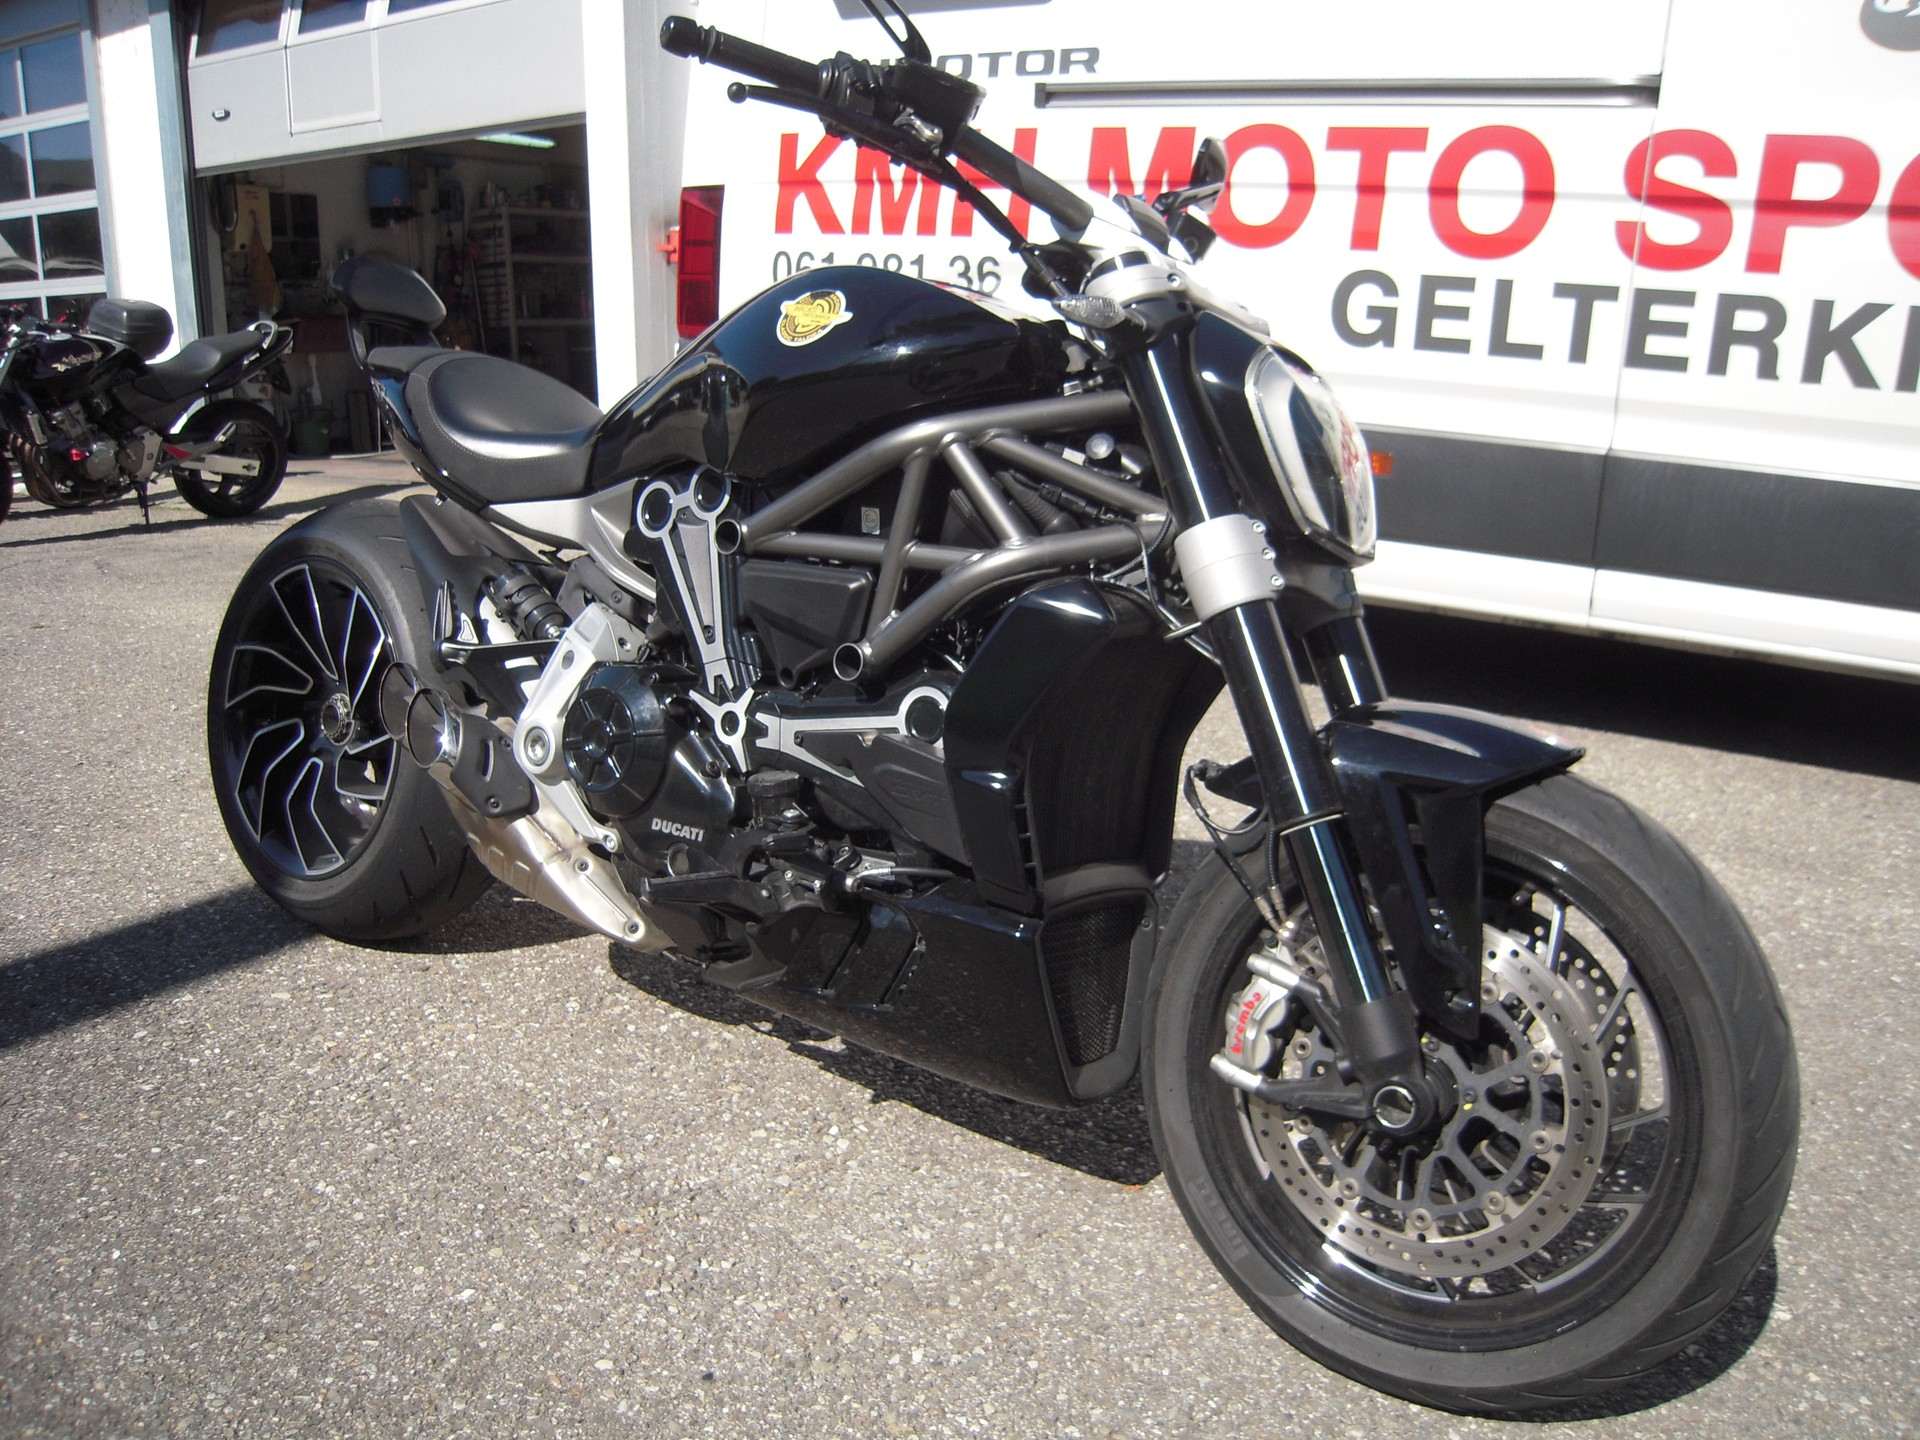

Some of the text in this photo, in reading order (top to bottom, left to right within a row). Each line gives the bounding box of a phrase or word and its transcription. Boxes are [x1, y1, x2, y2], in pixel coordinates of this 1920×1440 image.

[775, 123, 1920, 282] KMH MOTO SP
[1331, 269, 1920, 393] GELTERKI
[651, 817, 705, 842] DUCATI
[1230, 992, 1262, 1054] brembo
